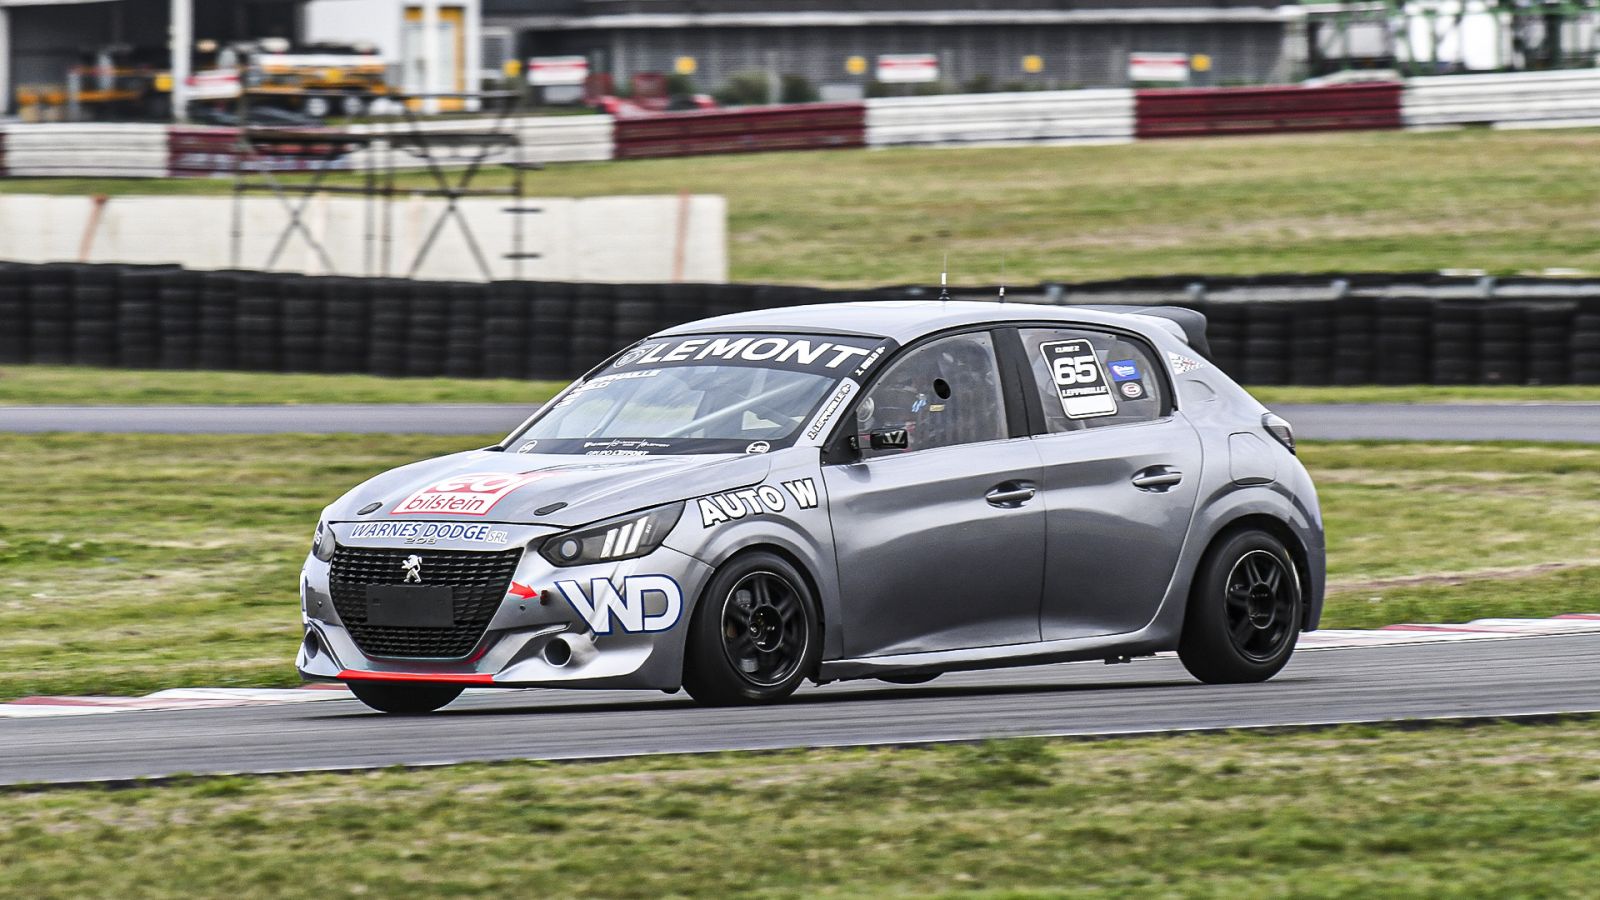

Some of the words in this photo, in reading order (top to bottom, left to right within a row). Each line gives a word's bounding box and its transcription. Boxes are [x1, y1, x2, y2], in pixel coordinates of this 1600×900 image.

[636, 337, 871, 369] LEMONT
[1053, 355, 1098, 385] 65
[404, 494, 485, 511] bilstein
[697, 484, 786, 529] AUTO
[780, 477, 819, 510] W
[351, 523, 422, 538] WARNES
[422, 524, 489, 541] DODGE
[487, 531, 507, 543] SRL
[554, 574, 683, 635] WD
